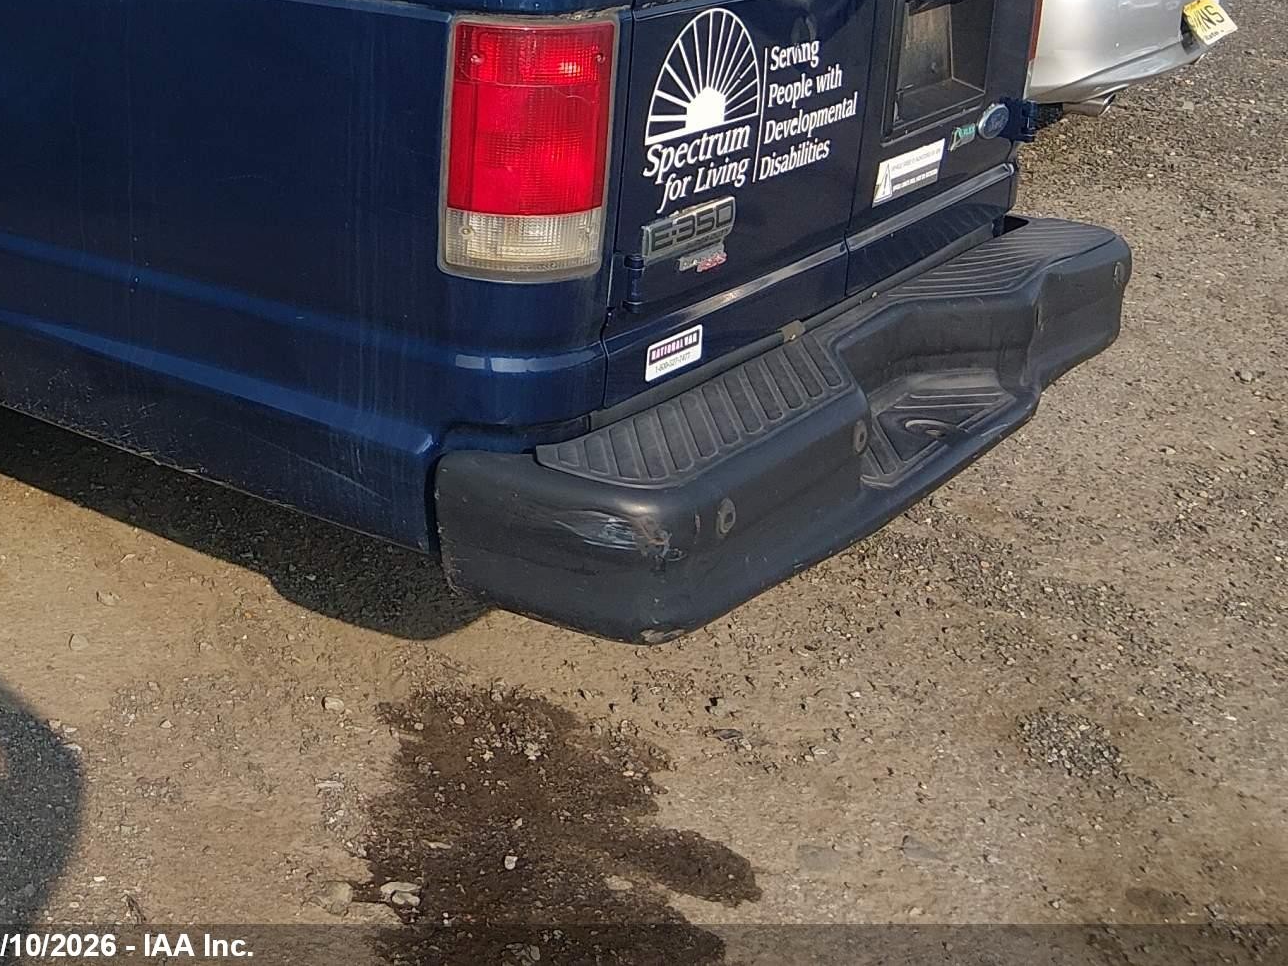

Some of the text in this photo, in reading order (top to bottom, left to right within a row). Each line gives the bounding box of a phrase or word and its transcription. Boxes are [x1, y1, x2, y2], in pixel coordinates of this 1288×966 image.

[770, 40, 820, 70] Serving
[768, 63, 842, 108] People with
[764, 91, 857, 144] Developmental
[643, 124, 750, 184] Spectrum
[759, 137, 830, 180] Disabilities
[657, 158, 751, 213] for Living
